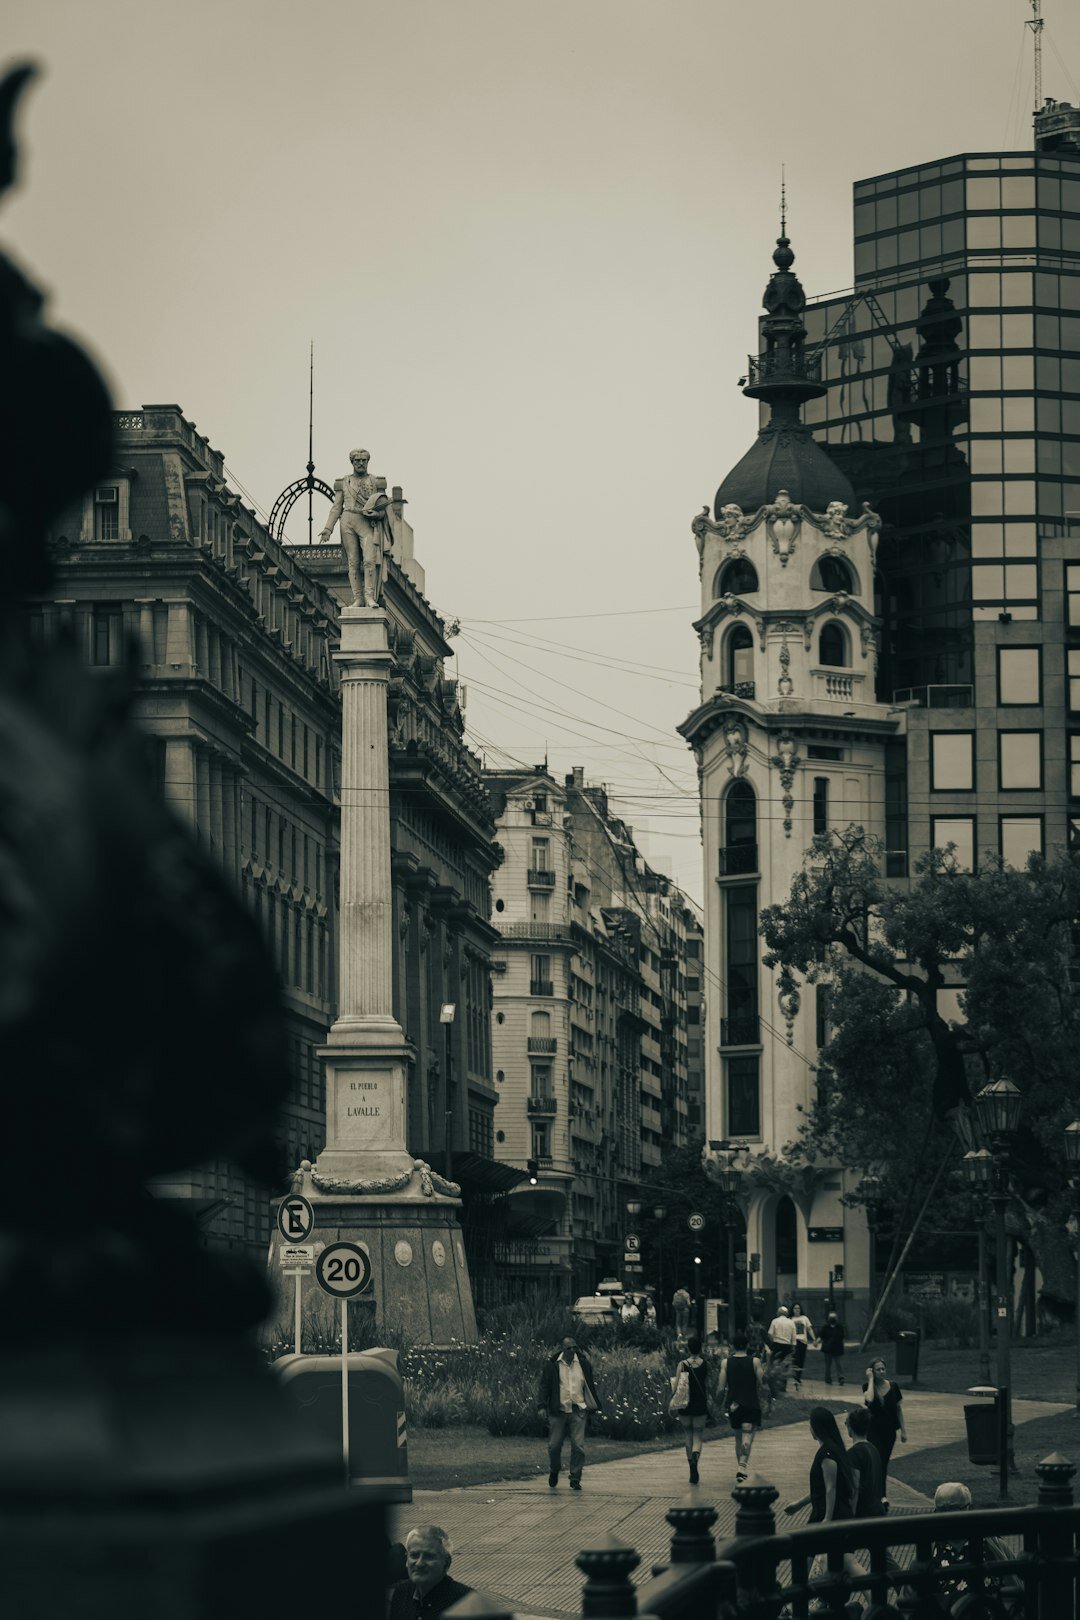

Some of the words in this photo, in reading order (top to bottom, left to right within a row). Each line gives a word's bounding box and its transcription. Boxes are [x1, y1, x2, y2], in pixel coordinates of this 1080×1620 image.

[350, 1082, 357, 1090] EL
[358, 1082, 378, 1090] PUEBLO
[347, 1107, 380, 1117] LAVALLE
[288, 1204, 304, 1233] E
[691, 1217, 702, 1226] 20
[327, 1258, 360, 1281] 20
